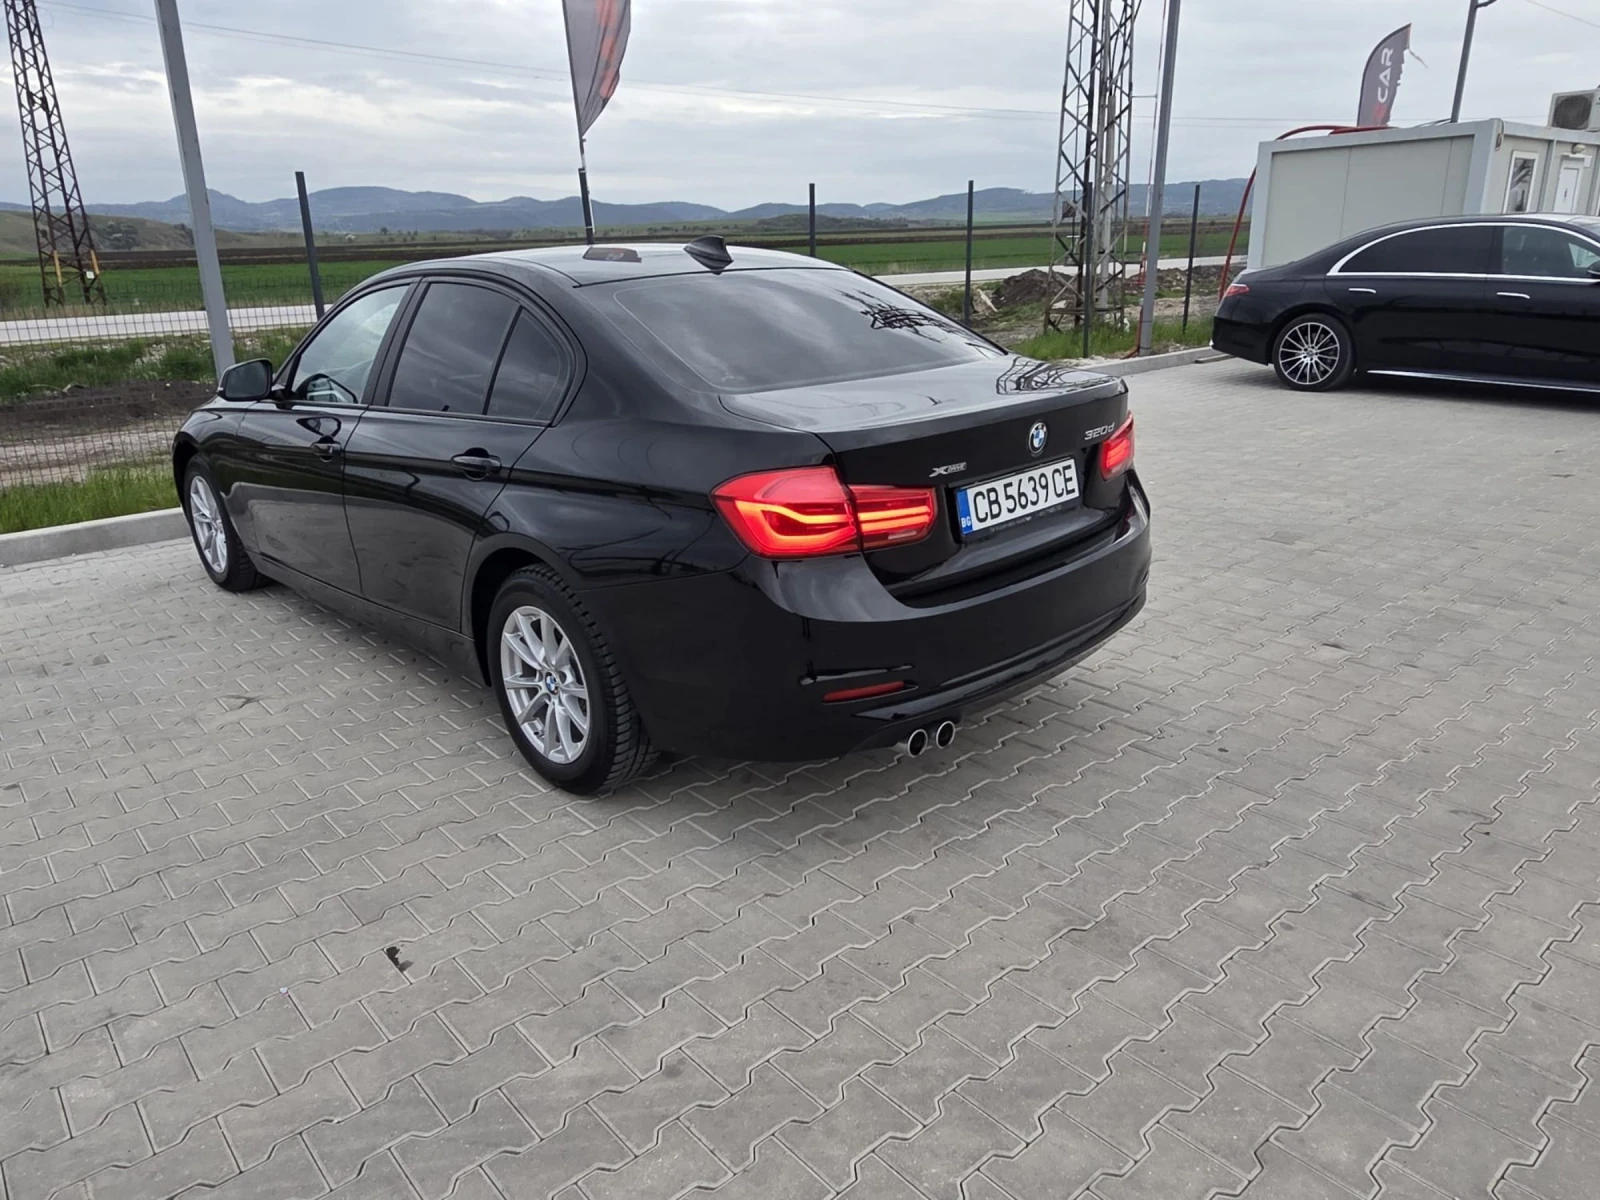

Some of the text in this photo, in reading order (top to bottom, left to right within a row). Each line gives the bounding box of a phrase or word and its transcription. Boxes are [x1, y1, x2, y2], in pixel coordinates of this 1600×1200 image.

[1084, 422, 1115, 441] 320d
[1004, 472, 1050, 514] 5639
[961, 515, 971, 527] BG
